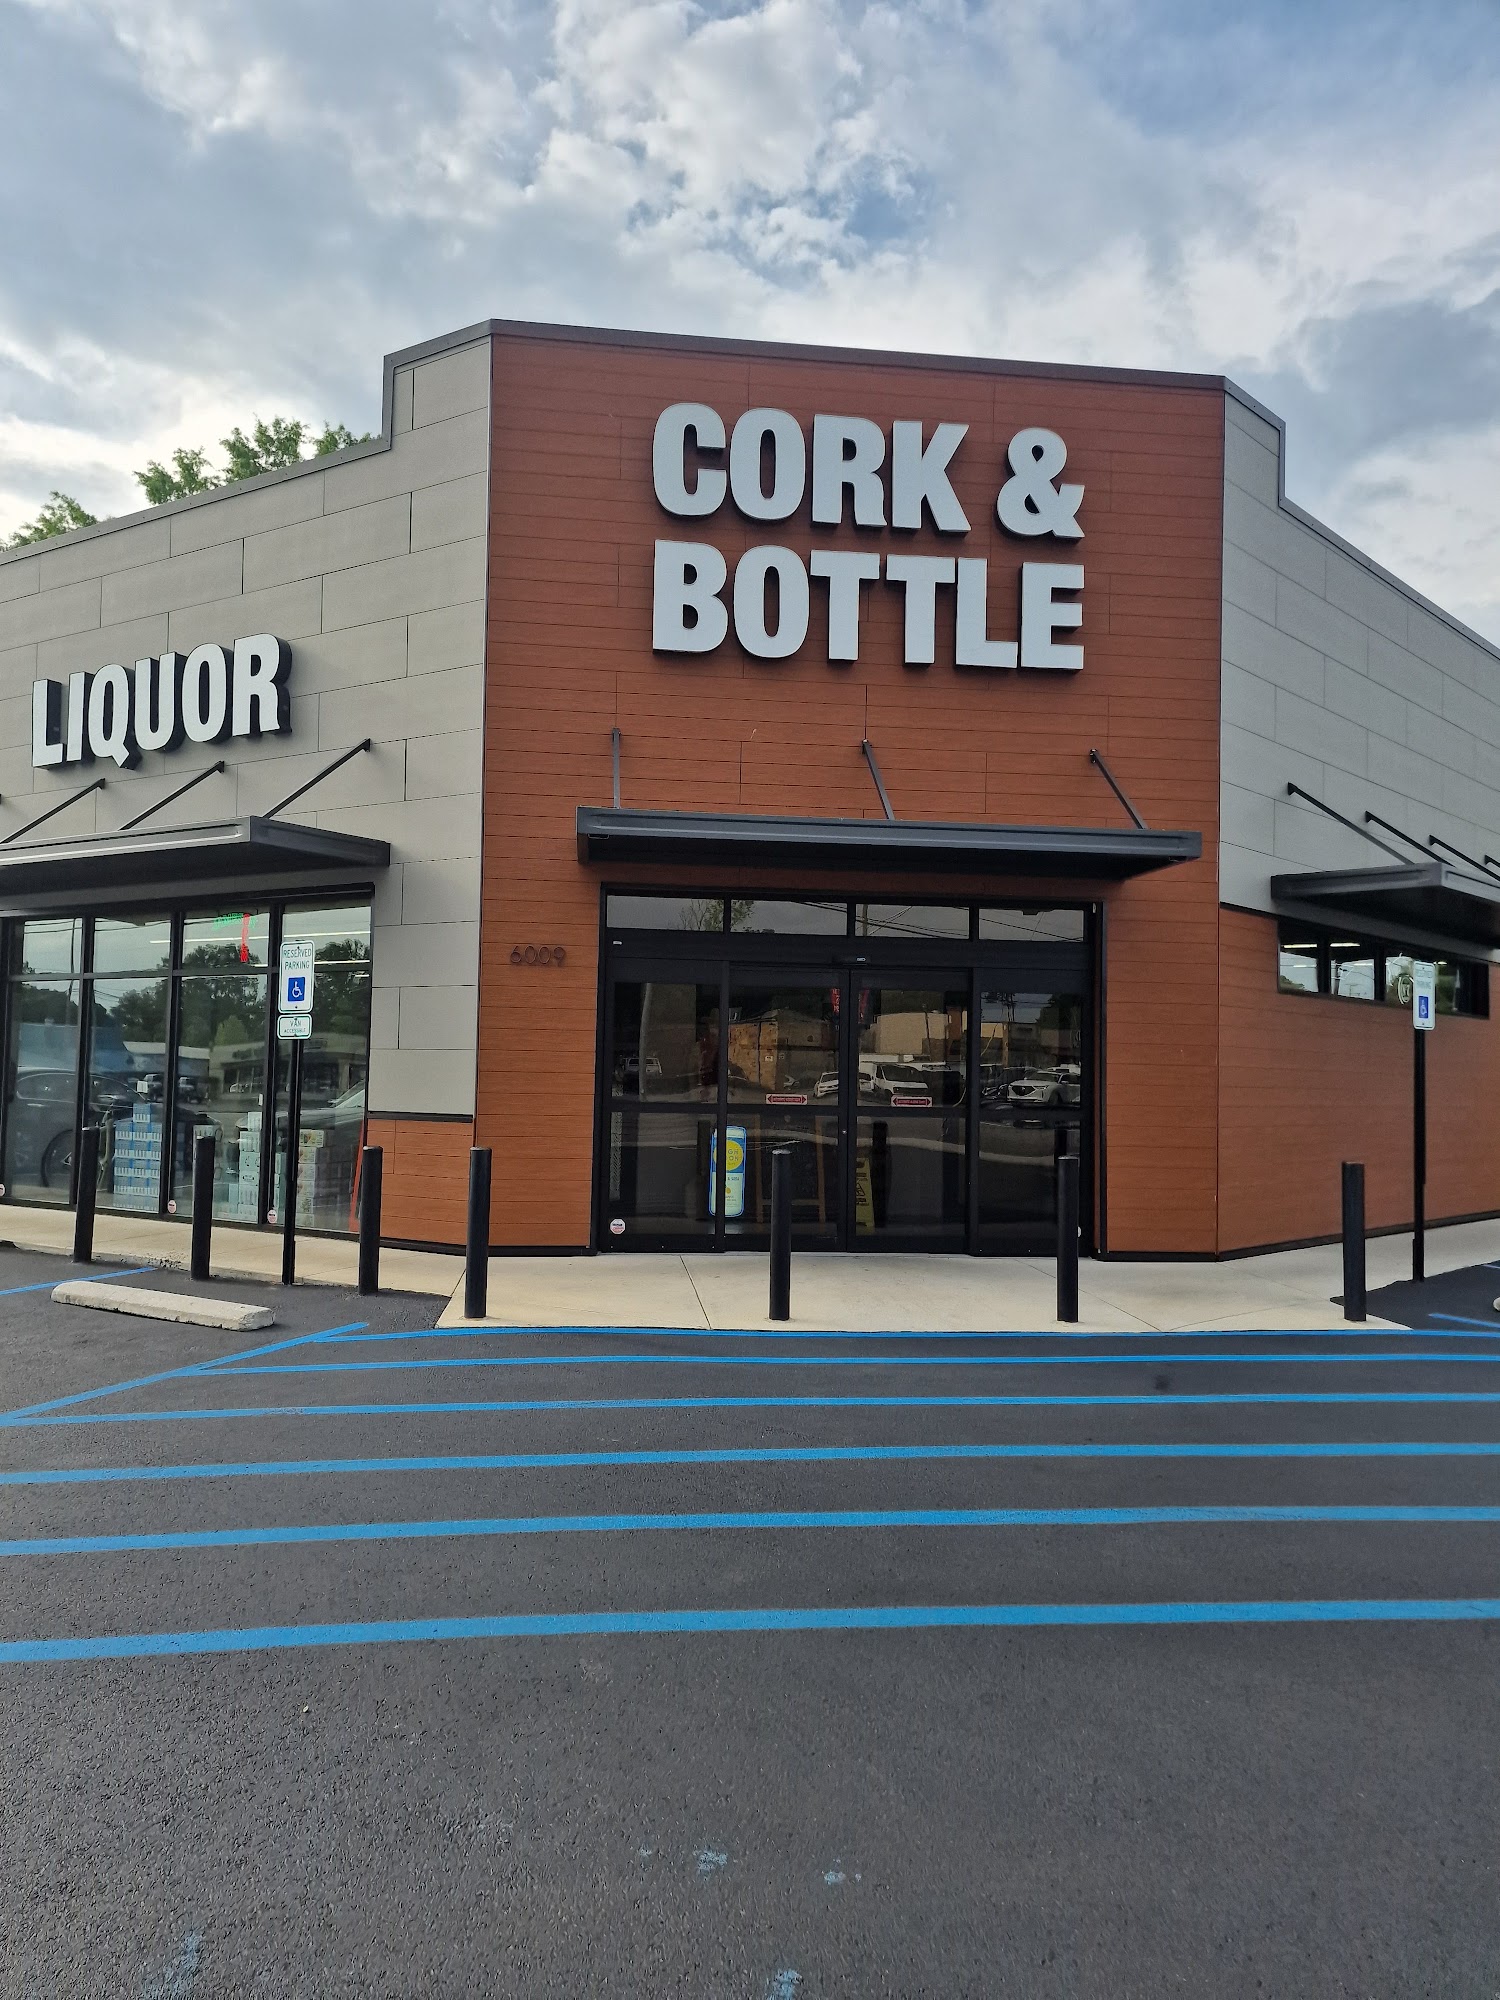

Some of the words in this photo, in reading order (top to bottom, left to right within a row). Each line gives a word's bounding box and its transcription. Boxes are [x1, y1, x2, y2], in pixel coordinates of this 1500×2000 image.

[652, 401, 972, 533] CORK
[997, 427, 1086, 539] &
[652, 538, 1086, 671] BOTTLE
[32, 633, 288, 769] LIQUOR
[283, 948, 312, 959] RESERVED
[510, 944, 566, 967] 6009
[284, 960, 310, 971] PARKING
[289, 1019, 302, 1027] VAN
